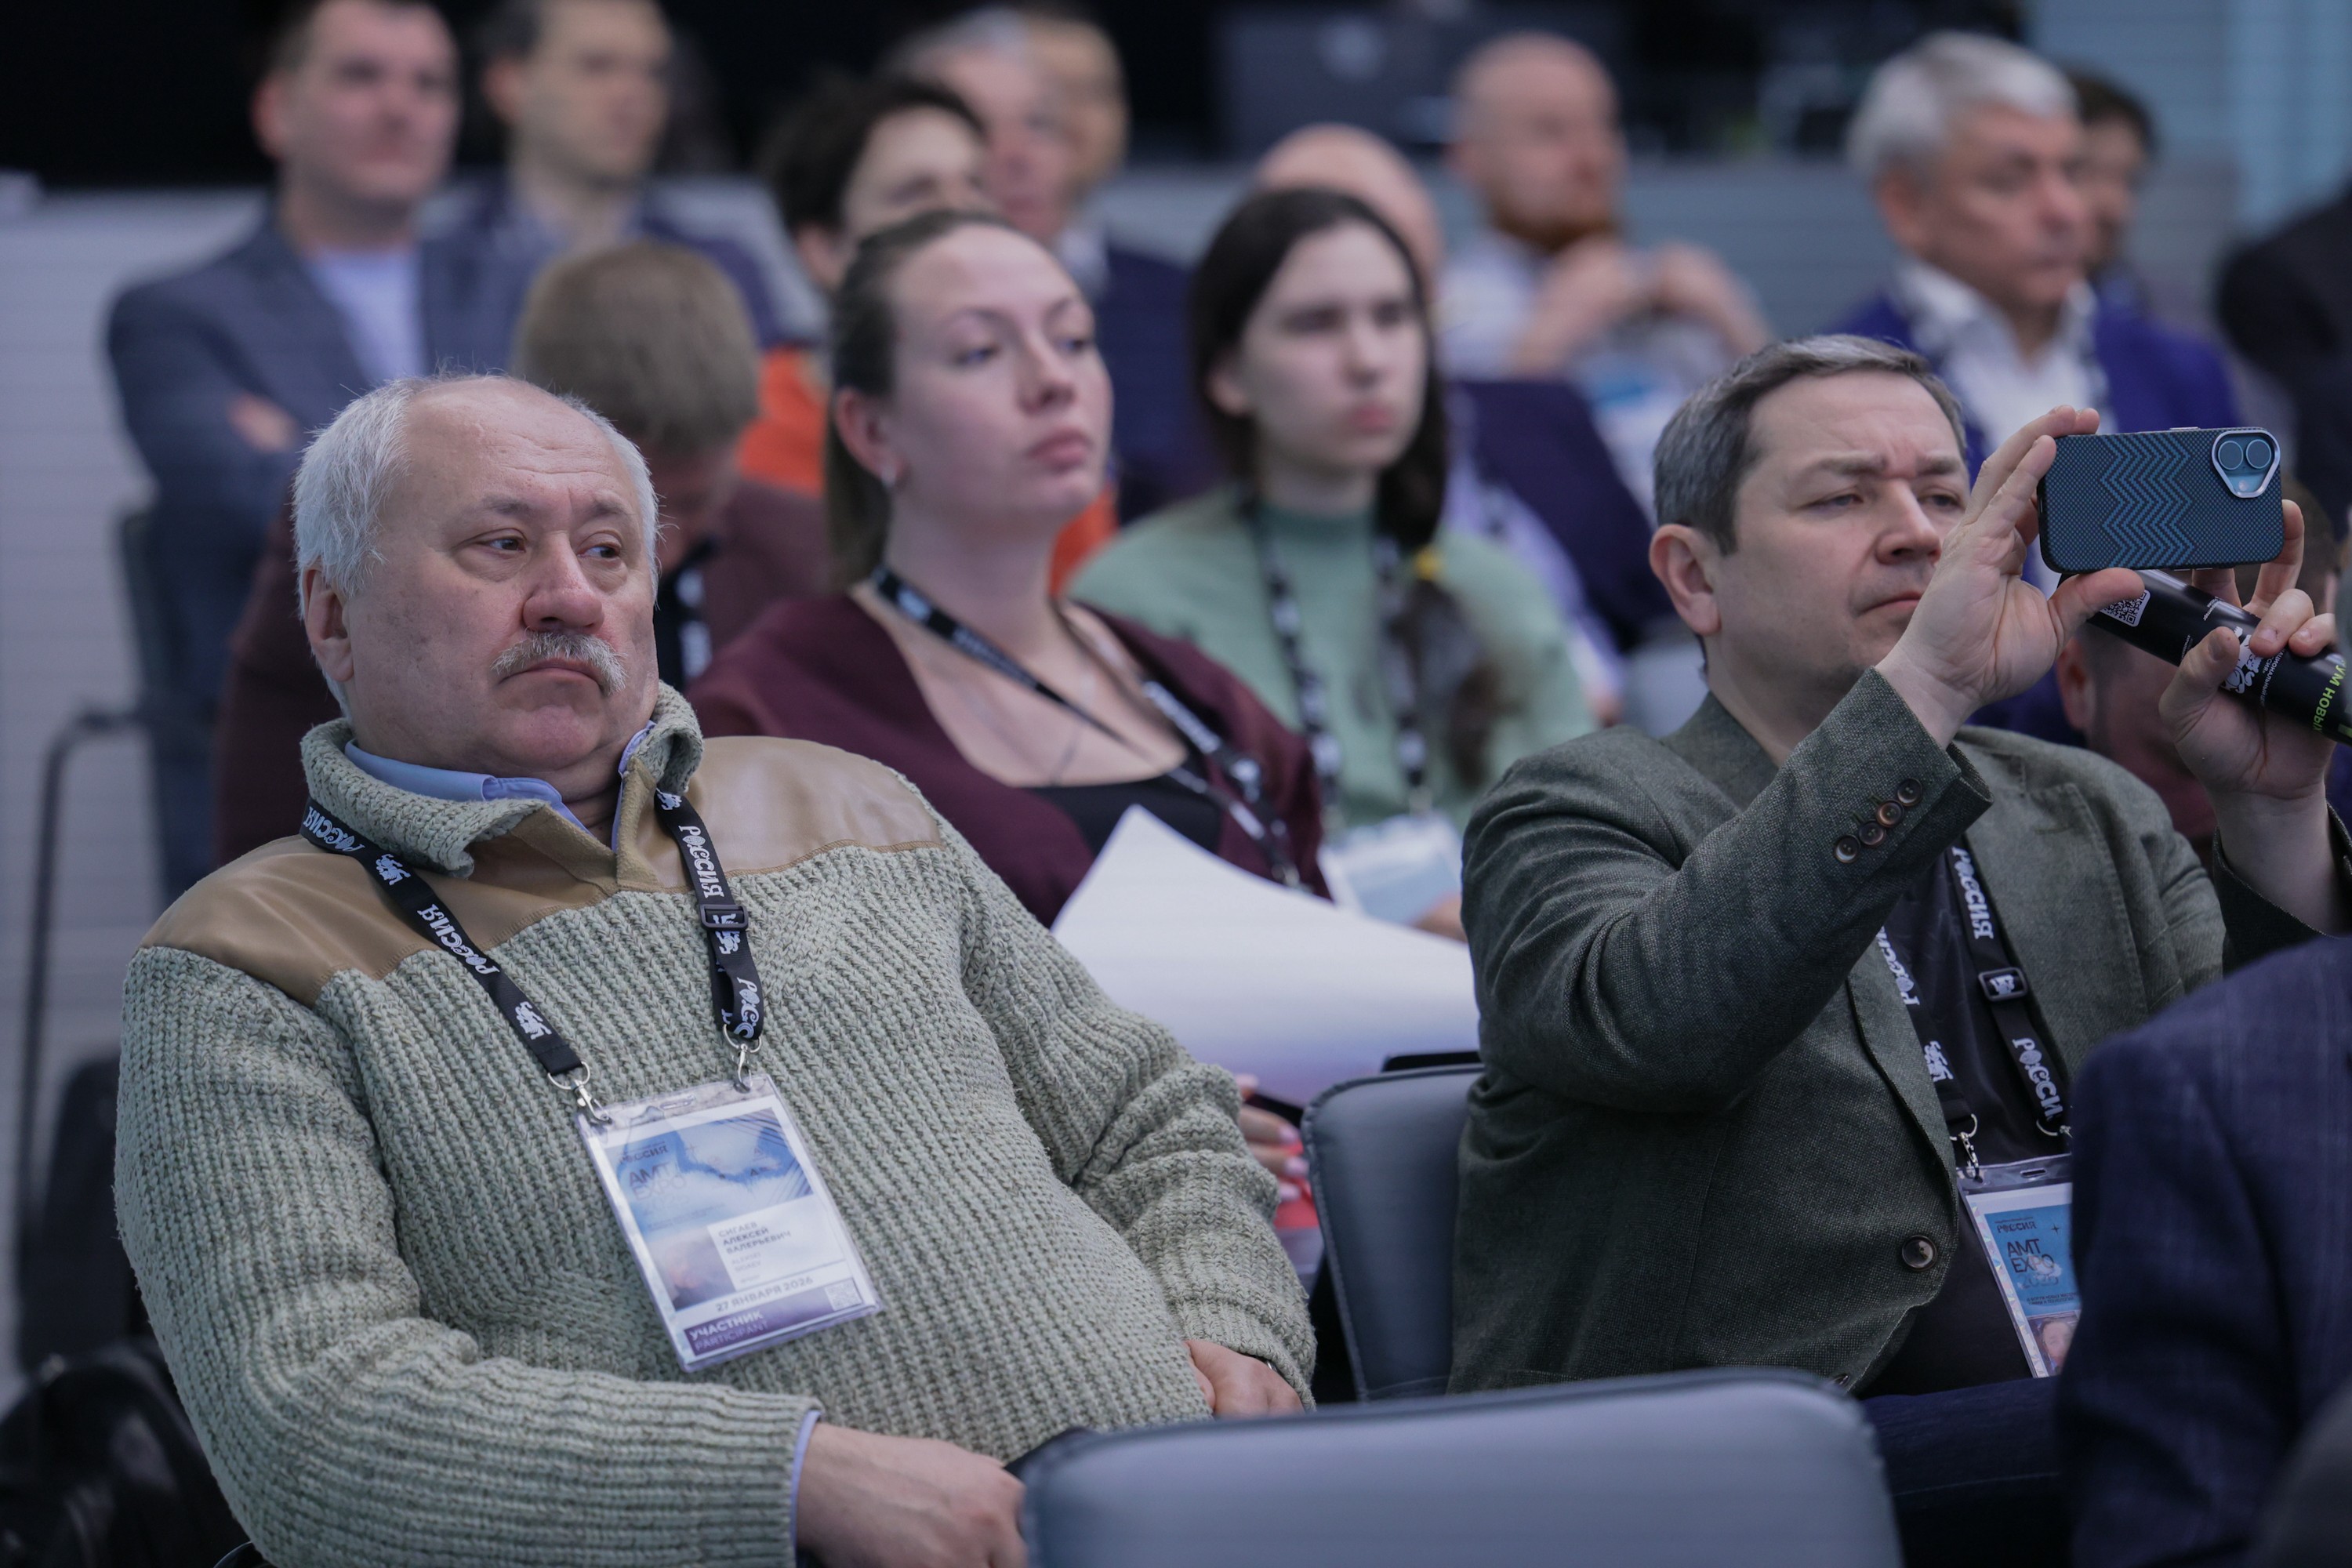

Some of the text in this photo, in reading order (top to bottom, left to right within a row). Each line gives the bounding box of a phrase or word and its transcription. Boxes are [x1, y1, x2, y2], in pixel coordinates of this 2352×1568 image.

[2329, 660, 2347, 687] УМ
[303, 806, 365, 852] РОССИЯ
[678, 825, 724, 898] РОССИЯ
[1951, 847, 1994, 939] РОССИЯ
[417, 904, 500, 975] РОССИЯ
[1876, 926, 1920, 1005] РОССИ
[734, 977, 760, 1039] РОСС
[2012, 1037, 2063, 1121] РОССИ
[723, 1226, 769, 1246] АЛЕКСЕЙ
[726, 1230, 792, 1254] ВАЛЕРЬЕВИЧ
[1997, 1221, 2037, 1233] РОССИЯ
[2008, 1239, 2041, 1258] AMT
[2011, 1254, 2054, 1273] EXPO
[716, 1301, 729, 1312] 27
[731, 1285, 782, 1307] ЯНВАРЯ
[688, 1310, 764, 1341] УЧАСТНИК
[694, 1319, 768, 1352] PARTICIPANT
